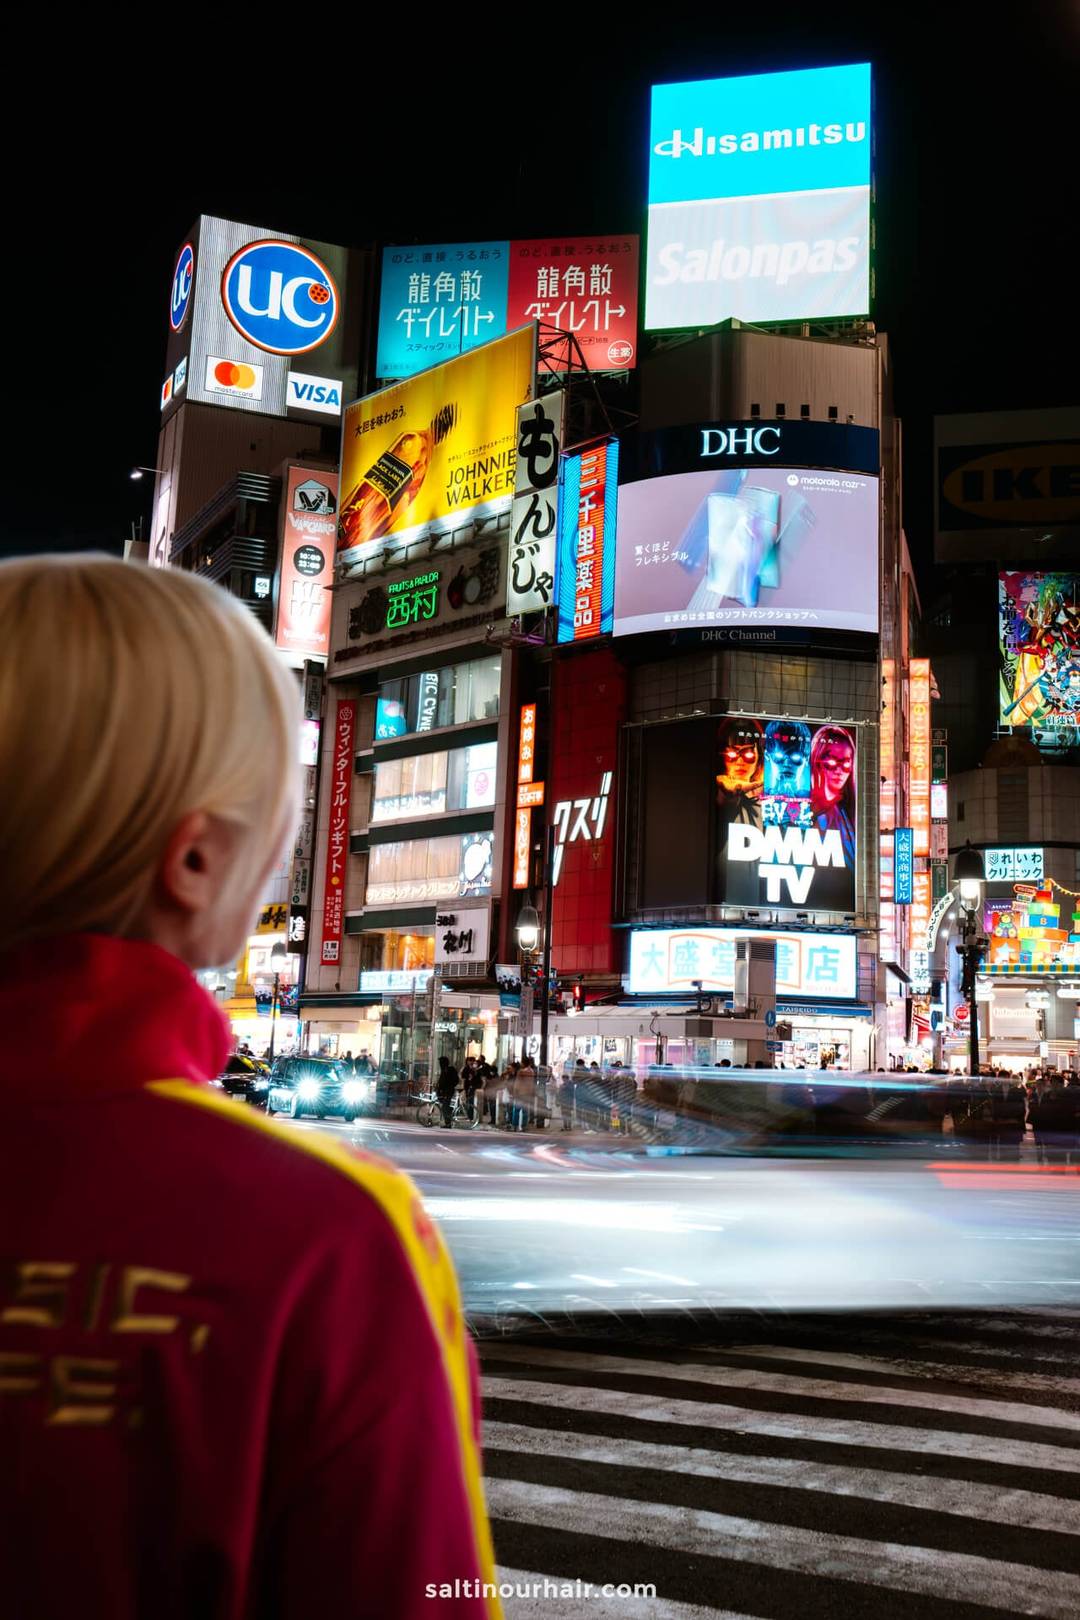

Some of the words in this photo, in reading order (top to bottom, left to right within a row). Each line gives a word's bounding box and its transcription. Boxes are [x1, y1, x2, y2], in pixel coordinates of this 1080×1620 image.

[654, 122, 866, 158] Hisamitsu
[653, 236, 860, 286] Salonpas
[237, 264, 327, 328] UC
[408, 269, 483, 304] 龍角散
[536, 263, 613, 299] 龍角散
[396, 305, 496, 338] ダイレクト
[214, 385, 254, 398] mastercard
[290, 380, 340, 406] VISA
[700, 427, 782, 457] DHC
[447, 447, 517, 489] JOHNNIE
[801, 476, 840, 487] motorola
[446, 469, 516, 507] WALKER
[512, 402, 560, 604] もんじゃ
[573, 455, 599, 628] 三千里薬品
[635, 551, 689, 567] フレキシブル
[387, 585, 438, 629] 西村
[701, 630, 728, 641] DHC
[729, 629, 777, 641] Channel
[331, 723, 350, 873] ウィンターフルーツギフト
[552, 771, 613, 887] クスリ
[728, 822, 846, 868] DMM
[988, 866, 1043, 880] クリニック
[1001, 850, 1043, 865] れいわ
[758, 864, 815, 904] TV
